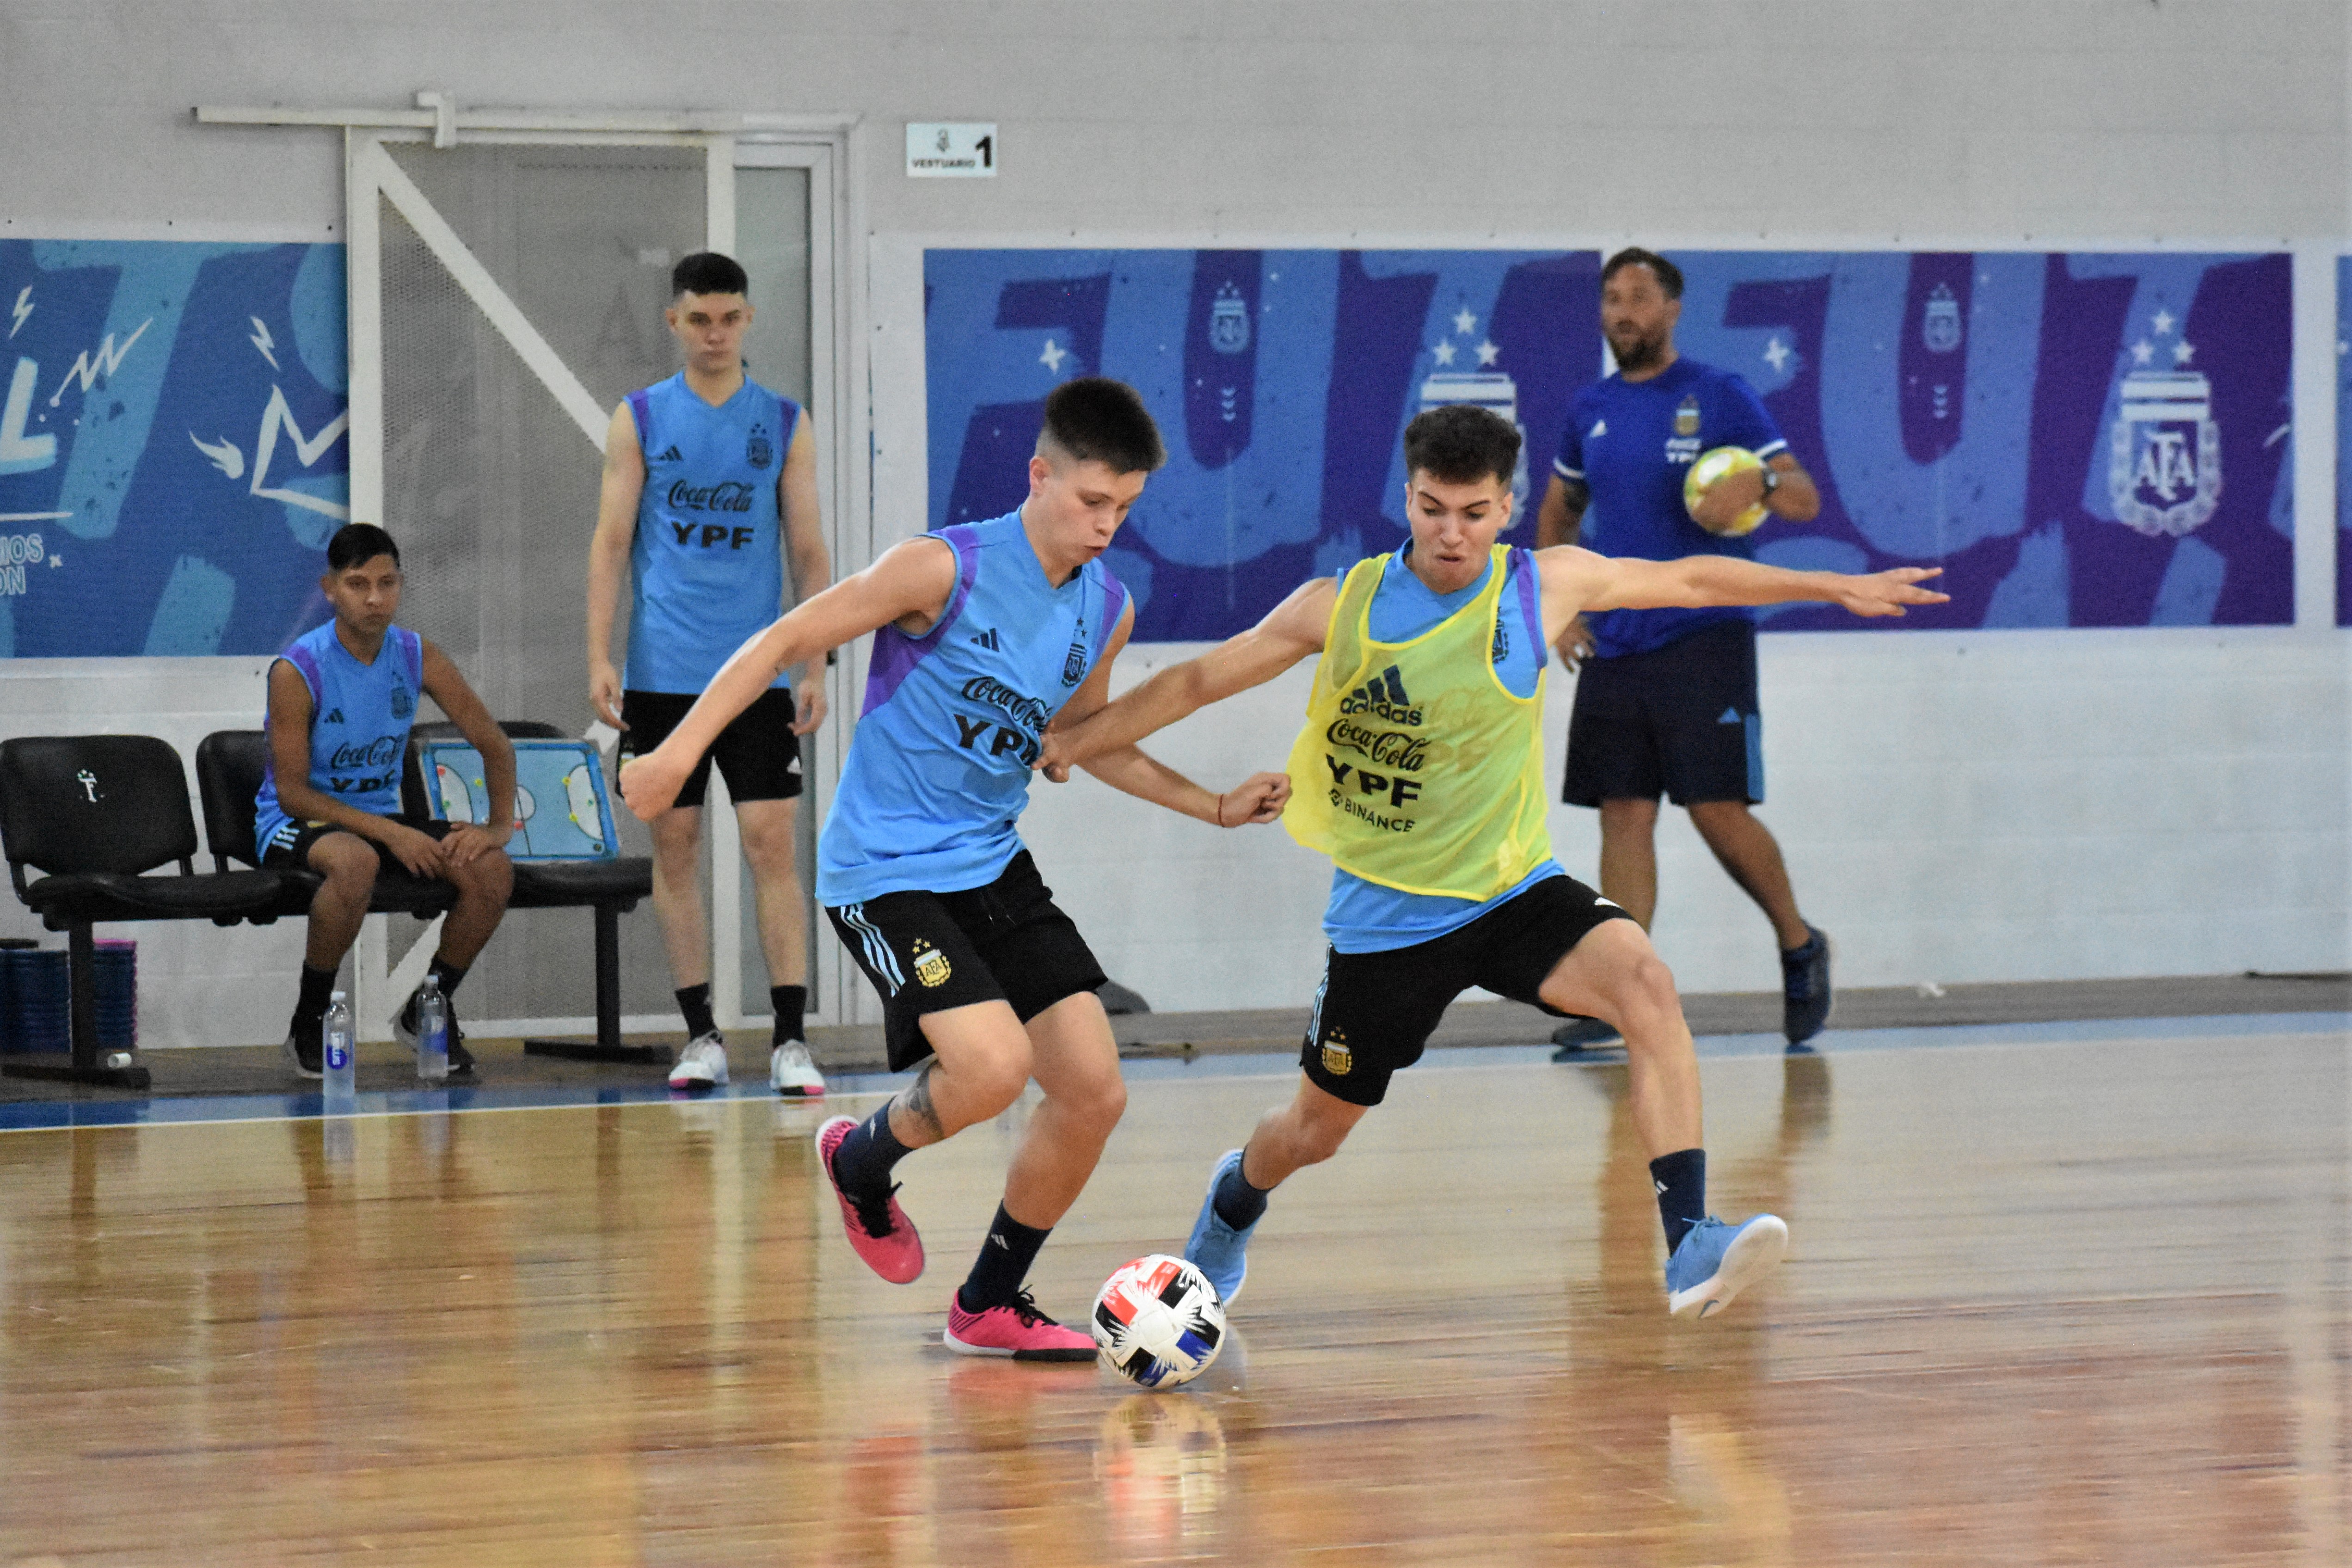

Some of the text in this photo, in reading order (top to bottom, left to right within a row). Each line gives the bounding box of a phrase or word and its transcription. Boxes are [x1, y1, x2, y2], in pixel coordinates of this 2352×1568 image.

[912, 135, 991, 168] VESTUARIO 1
[671, 521, 754, 549] YPF
[1340, 696, 1422, 726] adidas
[1326, 718, 1431, 772] Coca-Cola
[1326, 753, 1422, 808] YPF
[1345, 797, 1416, 832] BINANCE
